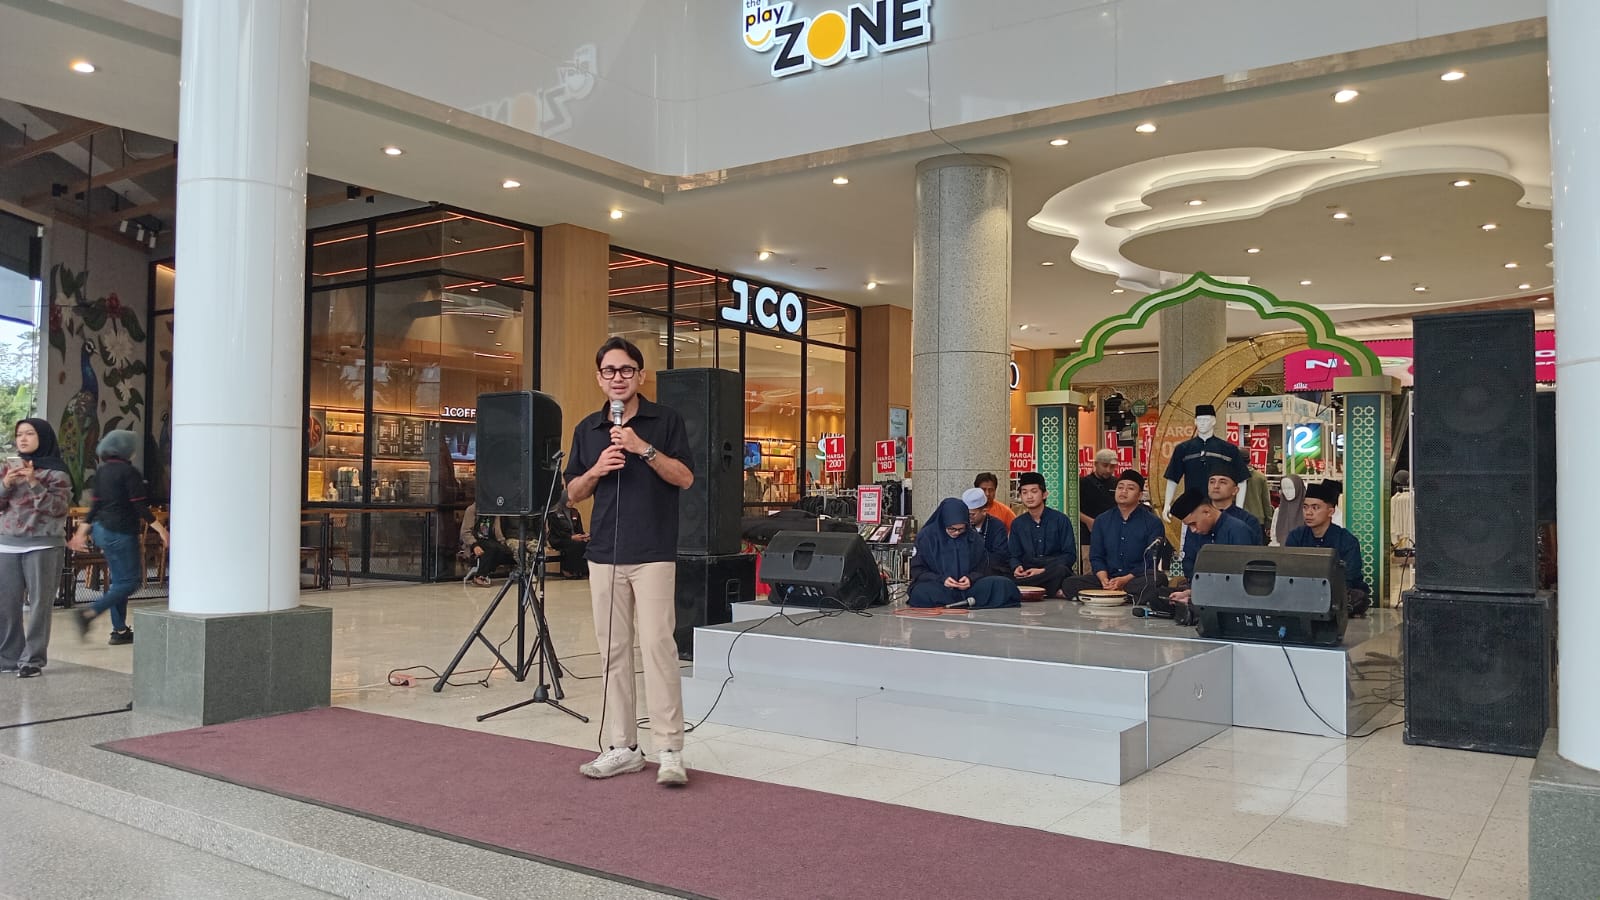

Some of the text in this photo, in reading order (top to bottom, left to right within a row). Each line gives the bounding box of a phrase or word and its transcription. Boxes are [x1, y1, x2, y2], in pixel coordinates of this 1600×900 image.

[746, 6, 784, 32] play
[774, 0, 923, 71] ZONE
[721, 279, 803, 333] J.CO
[1015, 436, 1024, 452] 1
[1226, 431, 1239, 442] 70
[1252, 437, 1267, 448] 70
[830, 438, 838, 453] 1
[881, 442, 888, 456] 1
[1252, 451, 1259, 464] 1
